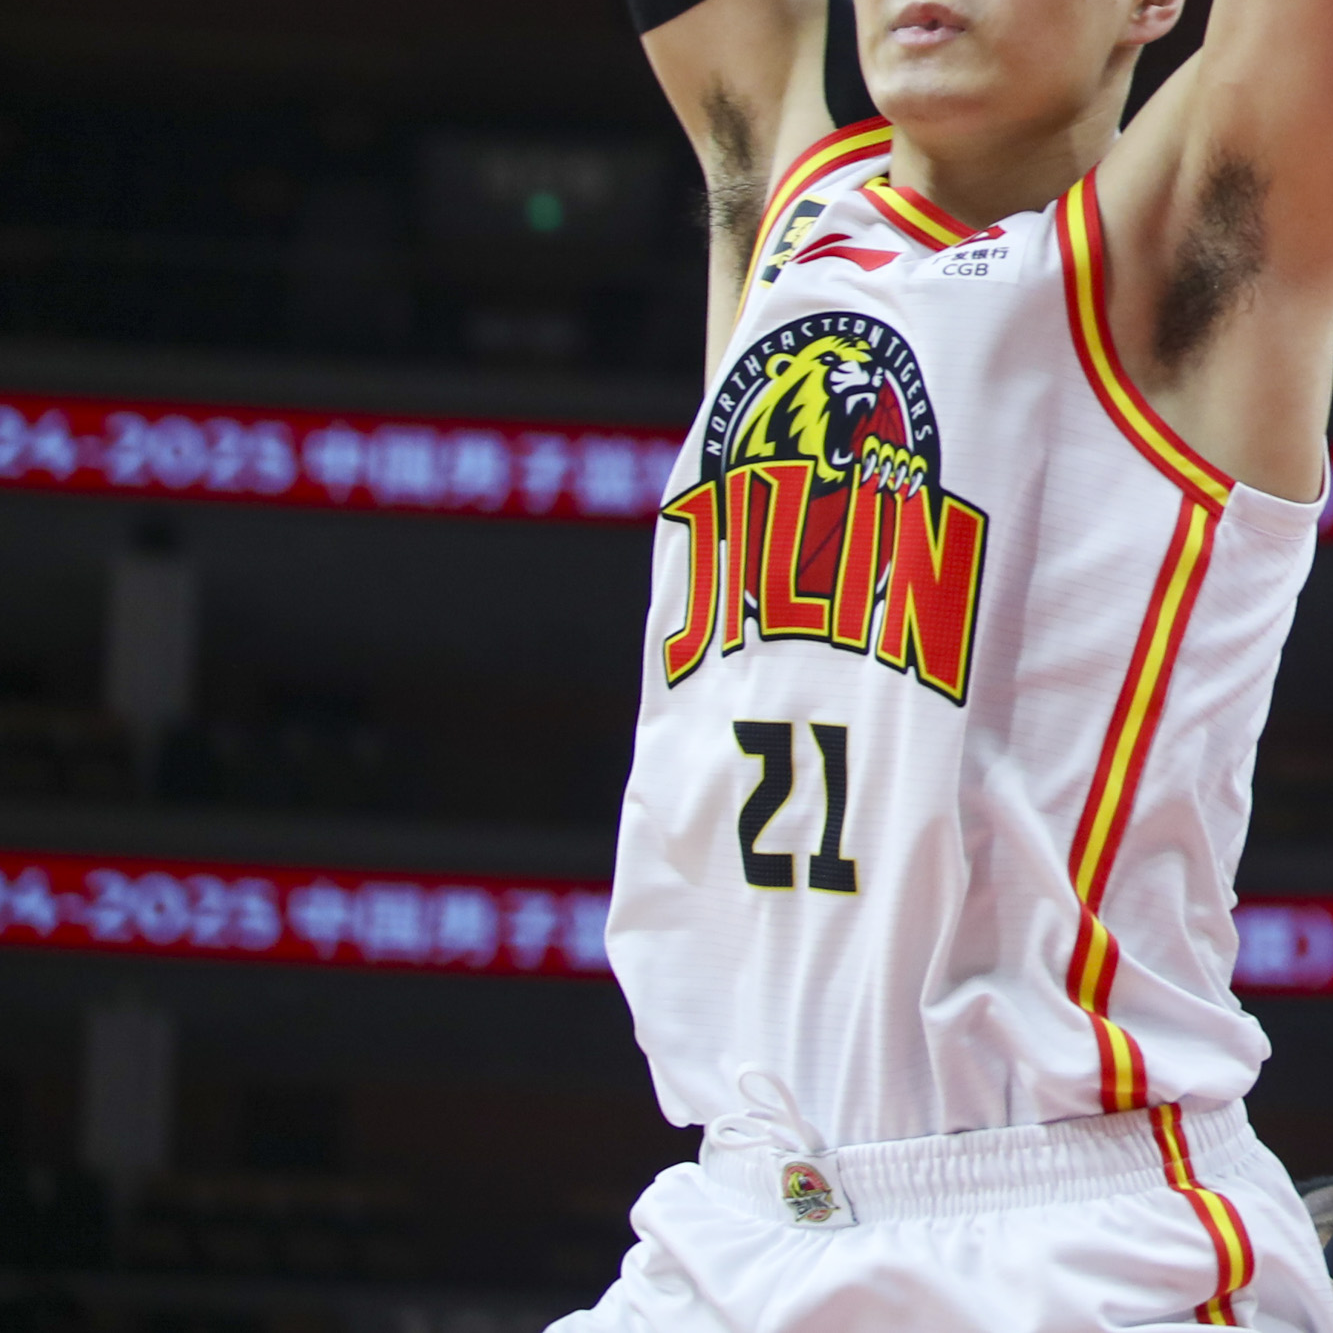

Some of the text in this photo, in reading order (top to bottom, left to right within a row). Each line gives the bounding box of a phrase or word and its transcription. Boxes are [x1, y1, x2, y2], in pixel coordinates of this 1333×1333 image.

[943, 263, 989, 276] CGB
[885, 336, 933, 441] TIGERS
[661, 459, 989, 706] JILIN
[732, 720, 860, 894] 21
[0, 867, 280, 950] 4-2025
